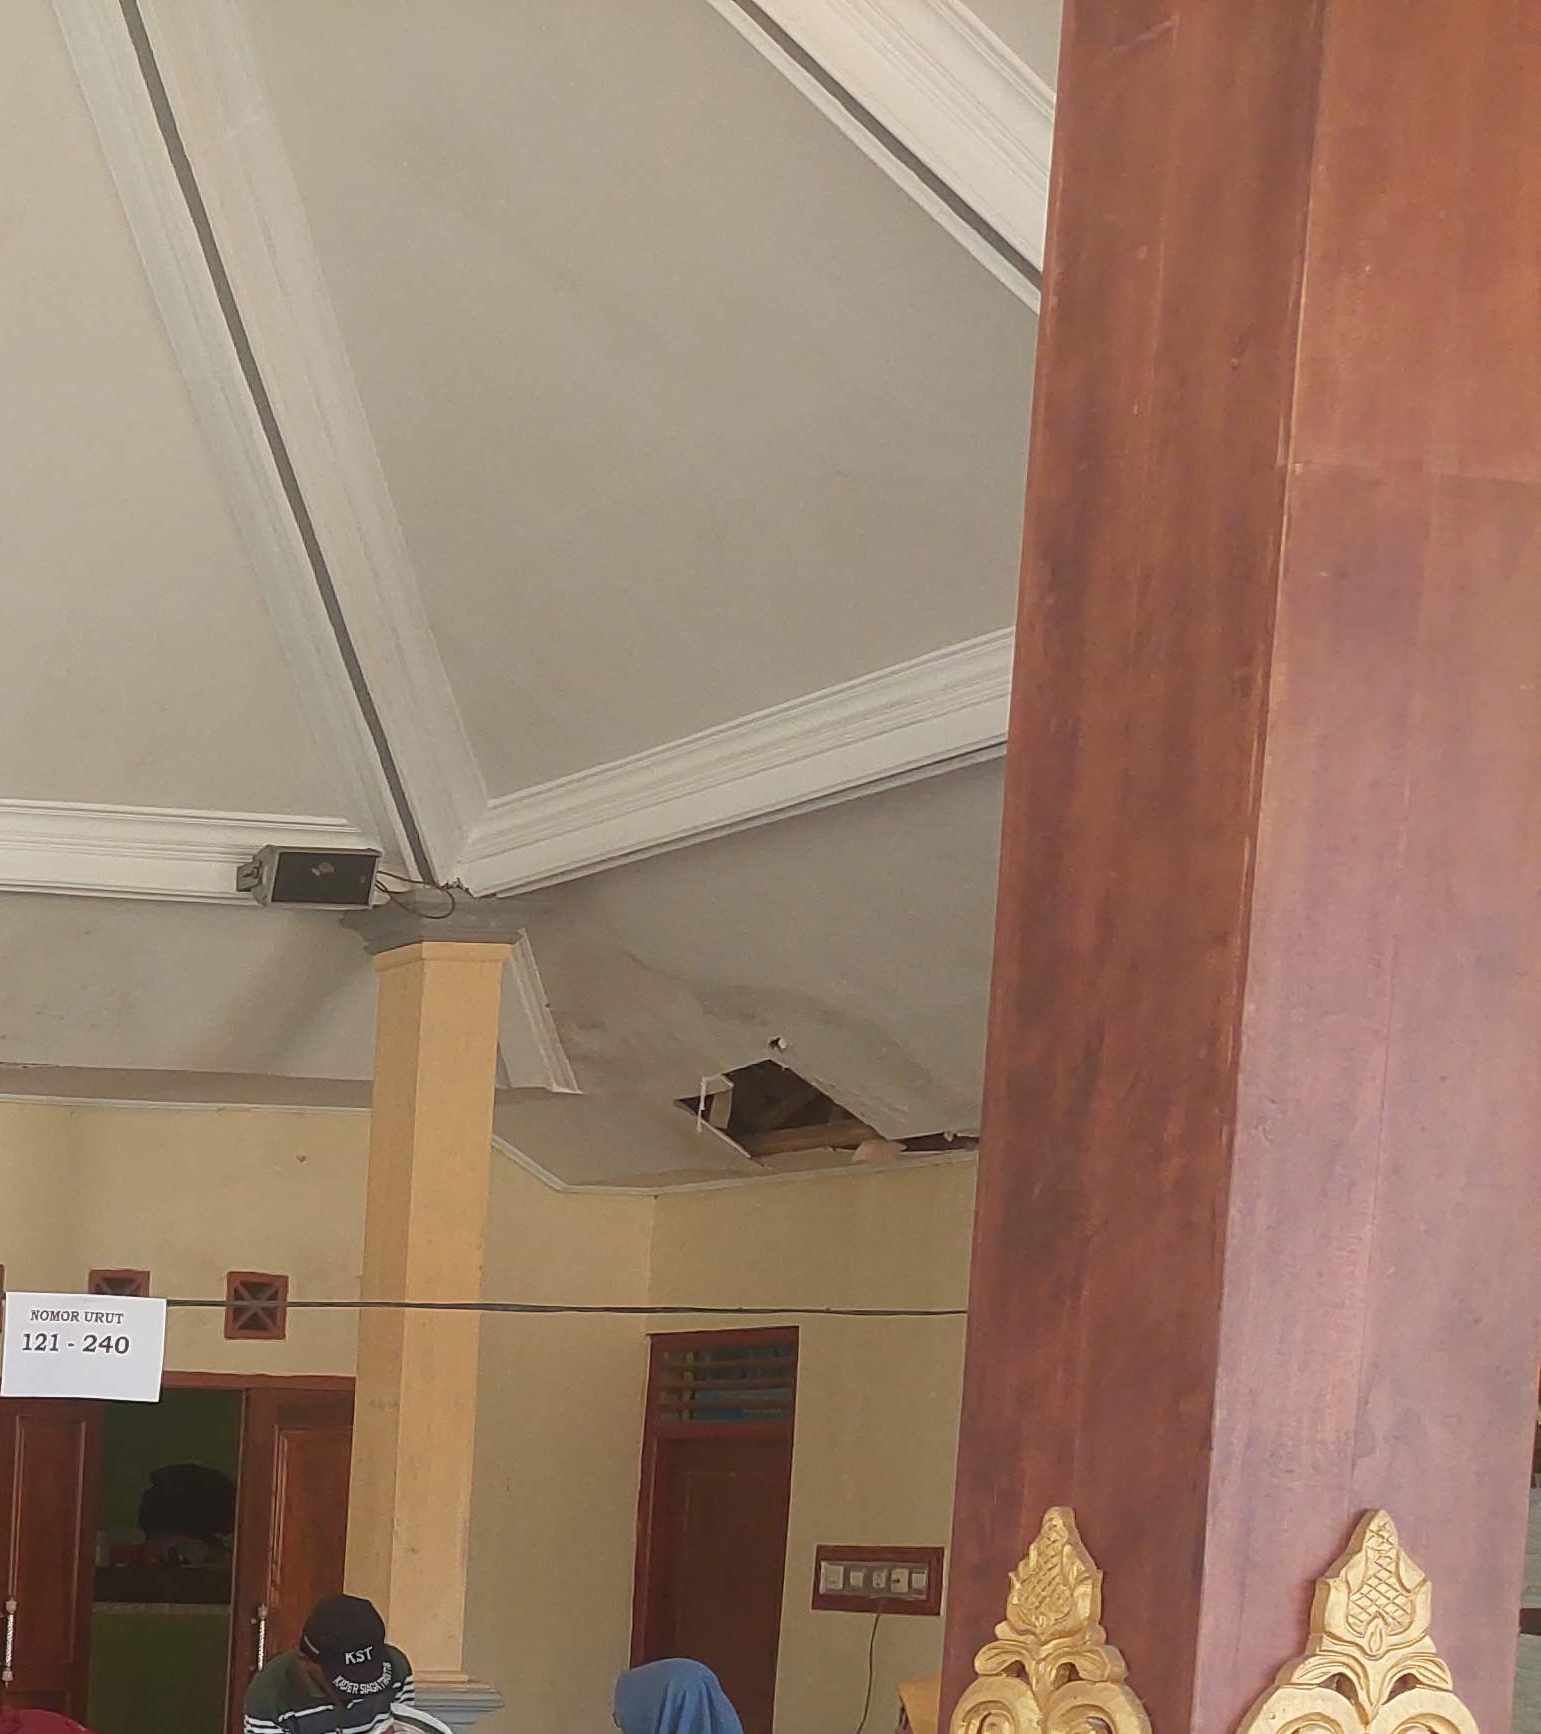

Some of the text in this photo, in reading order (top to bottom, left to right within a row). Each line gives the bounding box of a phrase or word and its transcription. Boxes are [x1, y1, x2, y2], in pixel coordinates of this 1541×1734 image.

[30, 1309, 124, 1325] NOMOR URUT
[22, 1333, 59, 1352] 121
[82, 1334, 130, 1355] 240
[345, 1646, 372, 1664] KST
[333, 1675, 359, 1694] KADER
[360, 1679, 383, 1695] SIAGA
